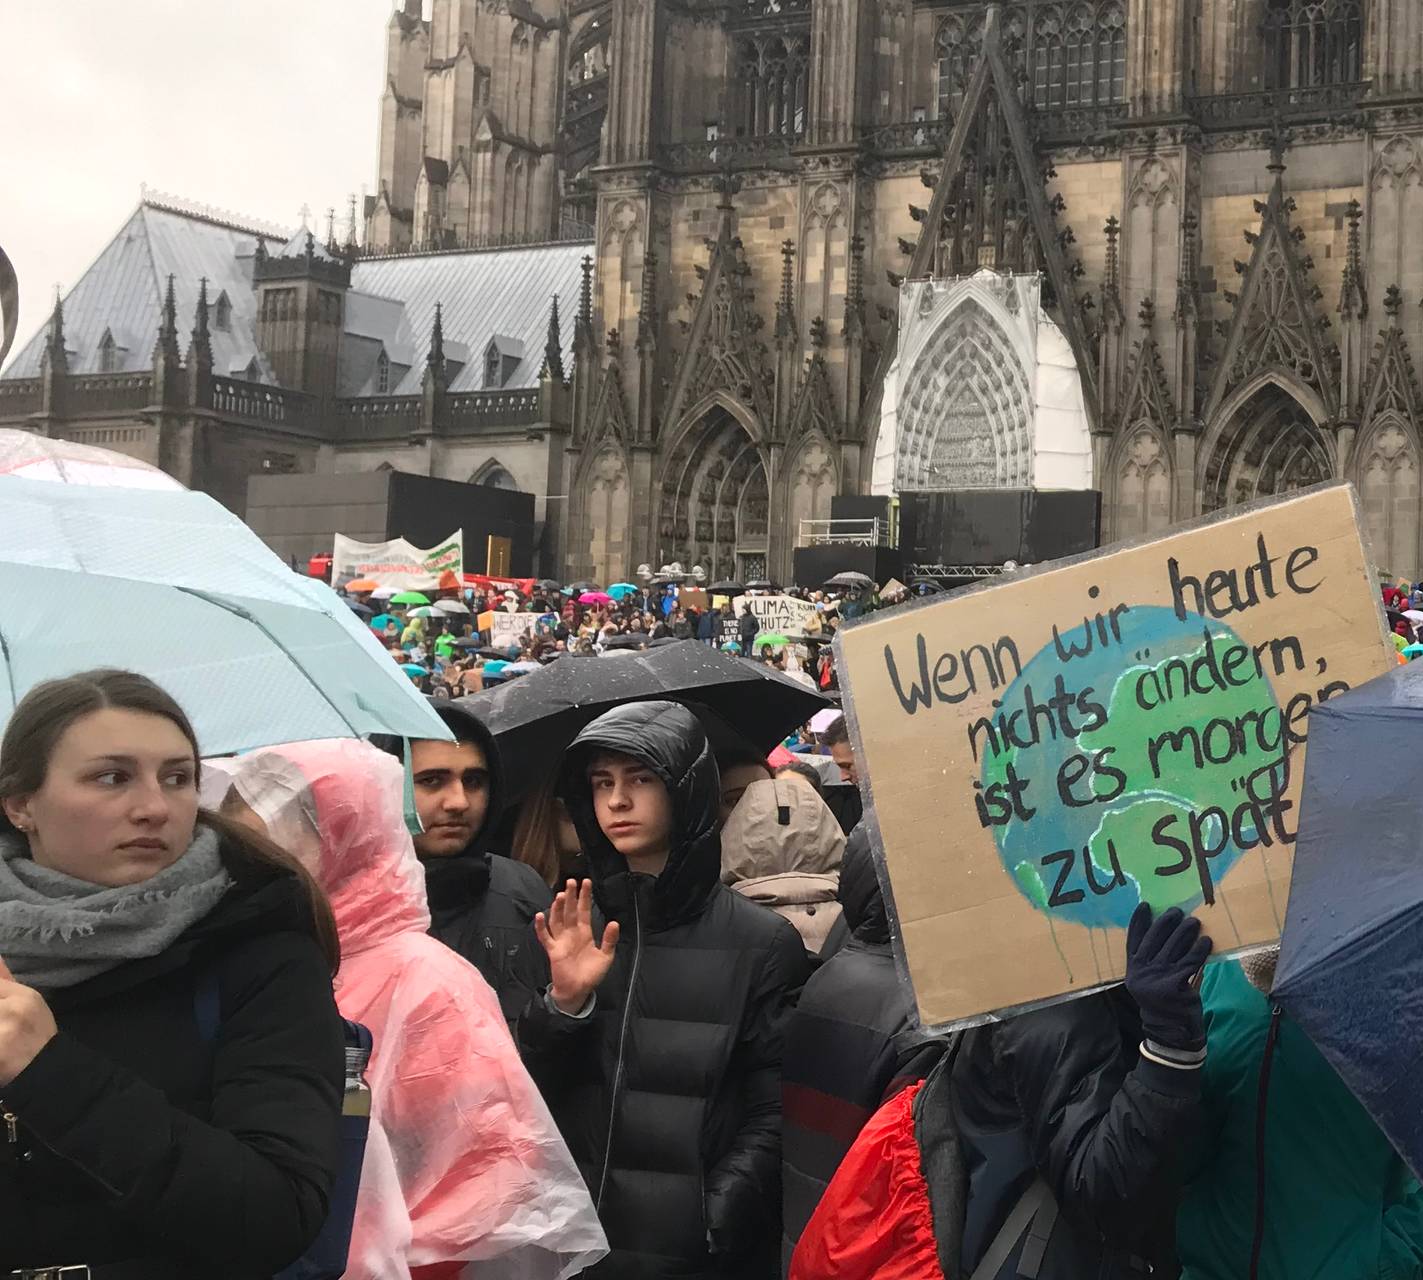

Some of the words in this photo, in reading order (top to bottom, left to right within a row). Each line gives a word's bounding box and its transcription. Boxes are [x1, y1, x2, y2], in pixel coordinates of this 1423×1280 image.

[757, 616, 790, 629] HUTZ
[884, 633, 1023, 715] Wenn
[1053, 585, 1128, 663] wir
[1168, 532, 1326, 621] heute
[967, 675, 1108, 762] nichts
[1135, 631, 1328, 712] ändern,
[972, 763, 1037, 828] ist
[1056, 746, 1127, 807] es
[1040, 838, 1127, 908] zu
[1150, 775, 1297, 907] spät
